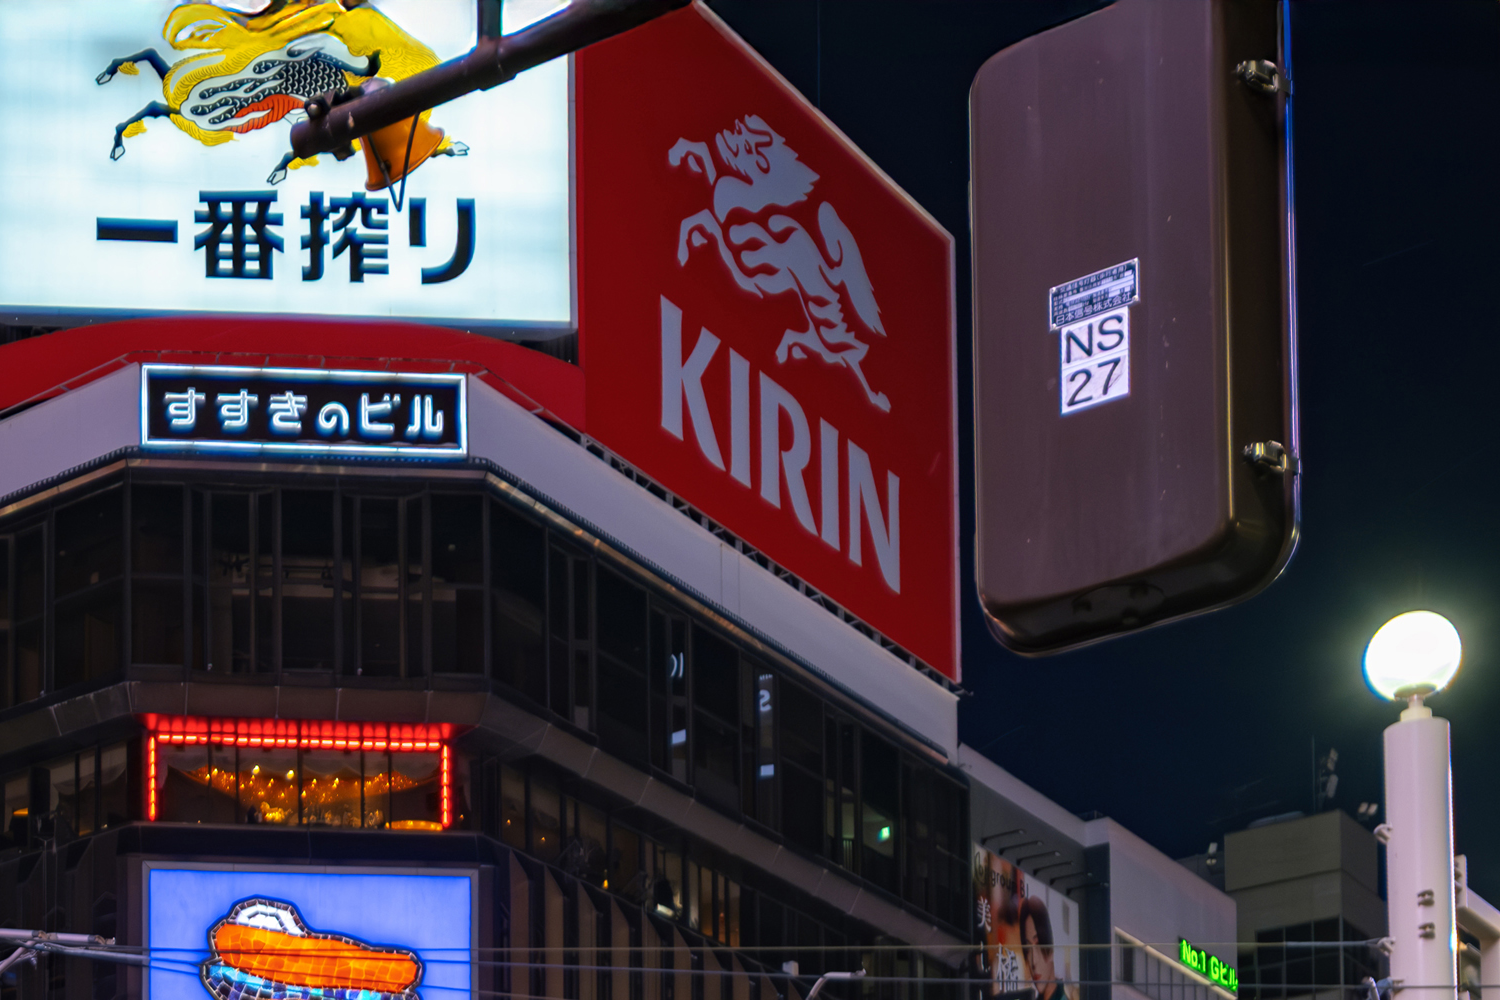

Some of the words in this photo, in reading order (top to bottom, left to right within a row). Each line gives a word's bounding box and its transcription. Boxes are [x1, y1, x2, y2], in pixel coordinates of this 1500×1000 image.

[95, 189, 476, 284] 一番搾り
[1066, 315, 1124, 364] NS
[1067, 356, 1122, 407] 27
[164, 386, 445, 437] すすきのビル
[659, 295, 900, 595] KIRIN
[1180, 938, 1206, 973] No.1
